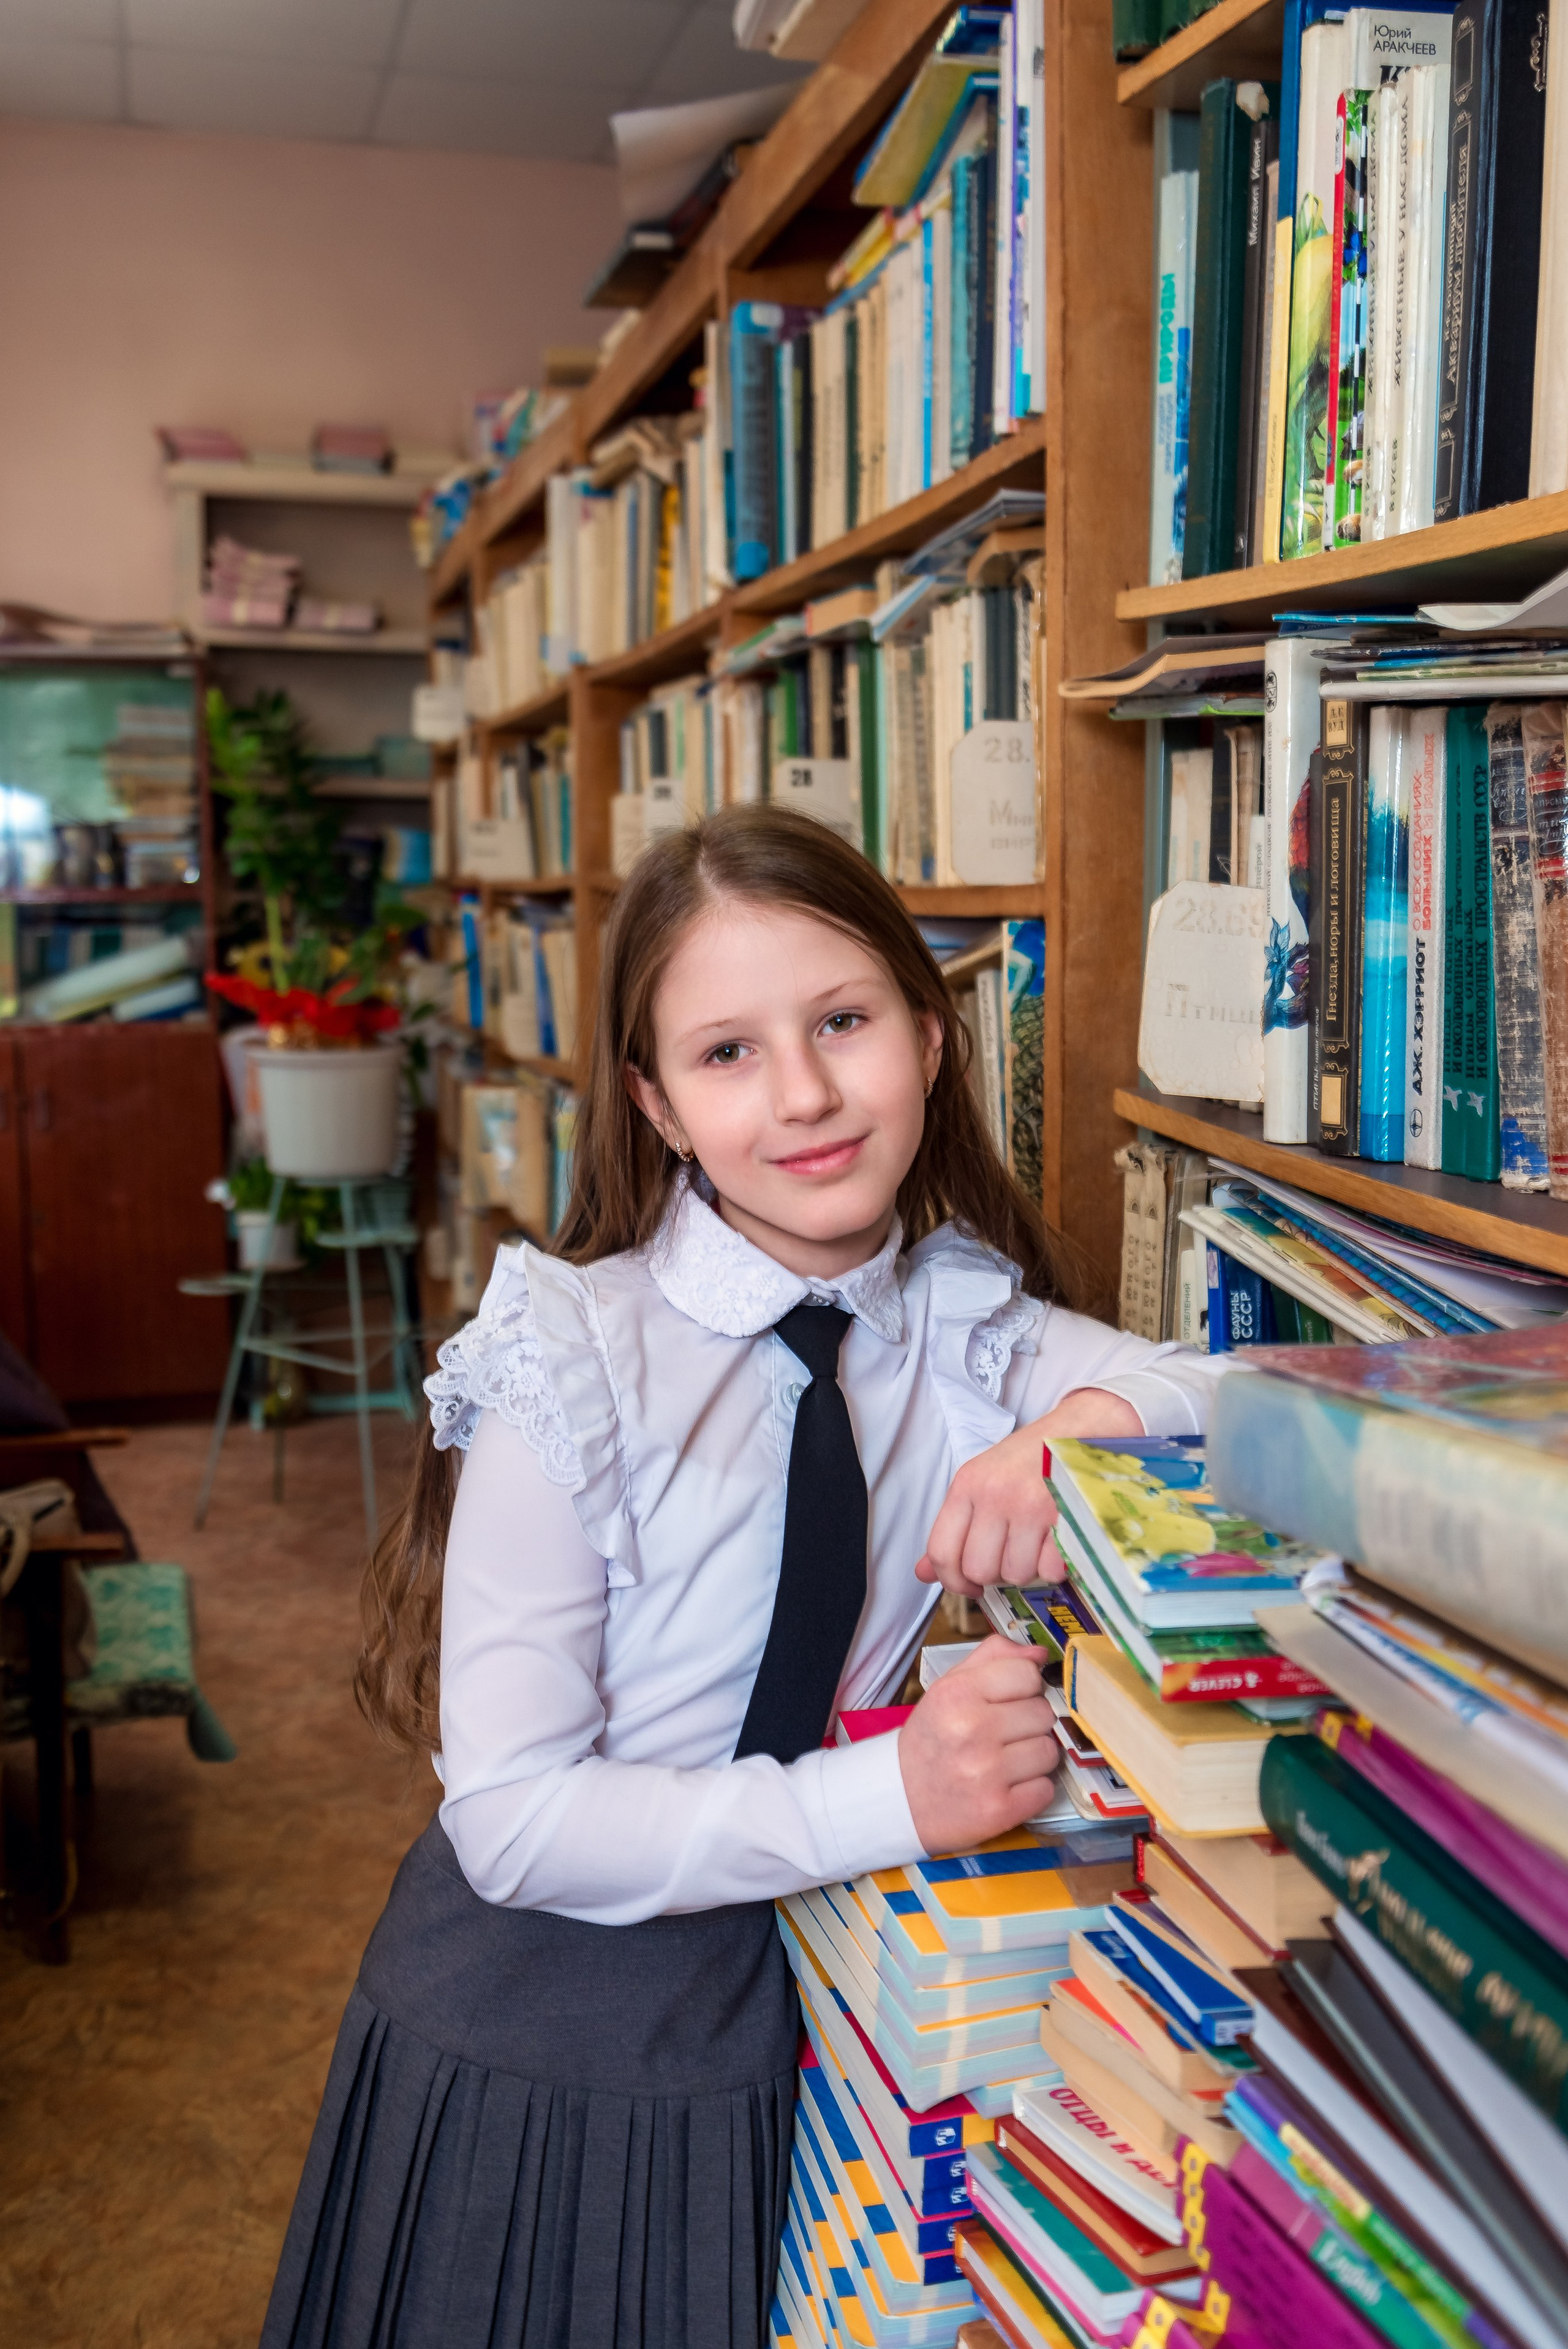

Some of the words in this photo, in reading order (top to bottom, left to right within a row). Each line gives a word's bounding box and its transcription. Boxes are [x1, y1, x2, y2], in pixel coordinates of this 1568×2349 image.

[1373, 40, 1437, 56] АРАКЧЕЕВ
[1374, 25, 1412, 41] Юрий
[1401, 94, 1409, 165] ДОМА
[1248, 185, 1261, 246] Михаил
[1399, 172, 1408, 221] НАС
[1394, 250, 1406, 388] ЖИВОТНЫЕ
[1447, 271, 1463, 385] Аквариум
[1424, 733, 1434, 809] МАЛЫХ
[1474, 765, 1487, 809] СССР
[1330, 797, 1340, 891] логовища
[1423, 815, 1433, 829] И
[1413, 876, 1422, 913] ВСЕХ
[1423, 834, 1433, 930] БОЛЬШИХ
[1474, 812, 1488, 928] ПРОСТРАНСТВ
[1330, 894, 1339, 906] и
[1413, 918, 1421, 931] О
[1330, 911, 1340, 957] норы
[1326, 959, 1340, 1022] Гнезда,
[1414, 938, 1427, 1041] ХЭРРИОТ
[1453, 938, 1464, 1058] ОКОЛОВОДНЫХ
[1476, 941, 1488, 1063] ОКОЛОВОДНЫХ
[1412, 1046, 1423, 1096] ДЖ.
[1452, 1061, 1463, 1074] И
[1477, 1066, 1488, 1079] И
[1231, 1290, 1240, 1340] ФАУНЫ
[1240, 1289, 1253, 1338] СССР
[1188, 1676, 1243, 1692] CLEVER
[1049, 2088, 1118, 2140] ОТЦЫ
